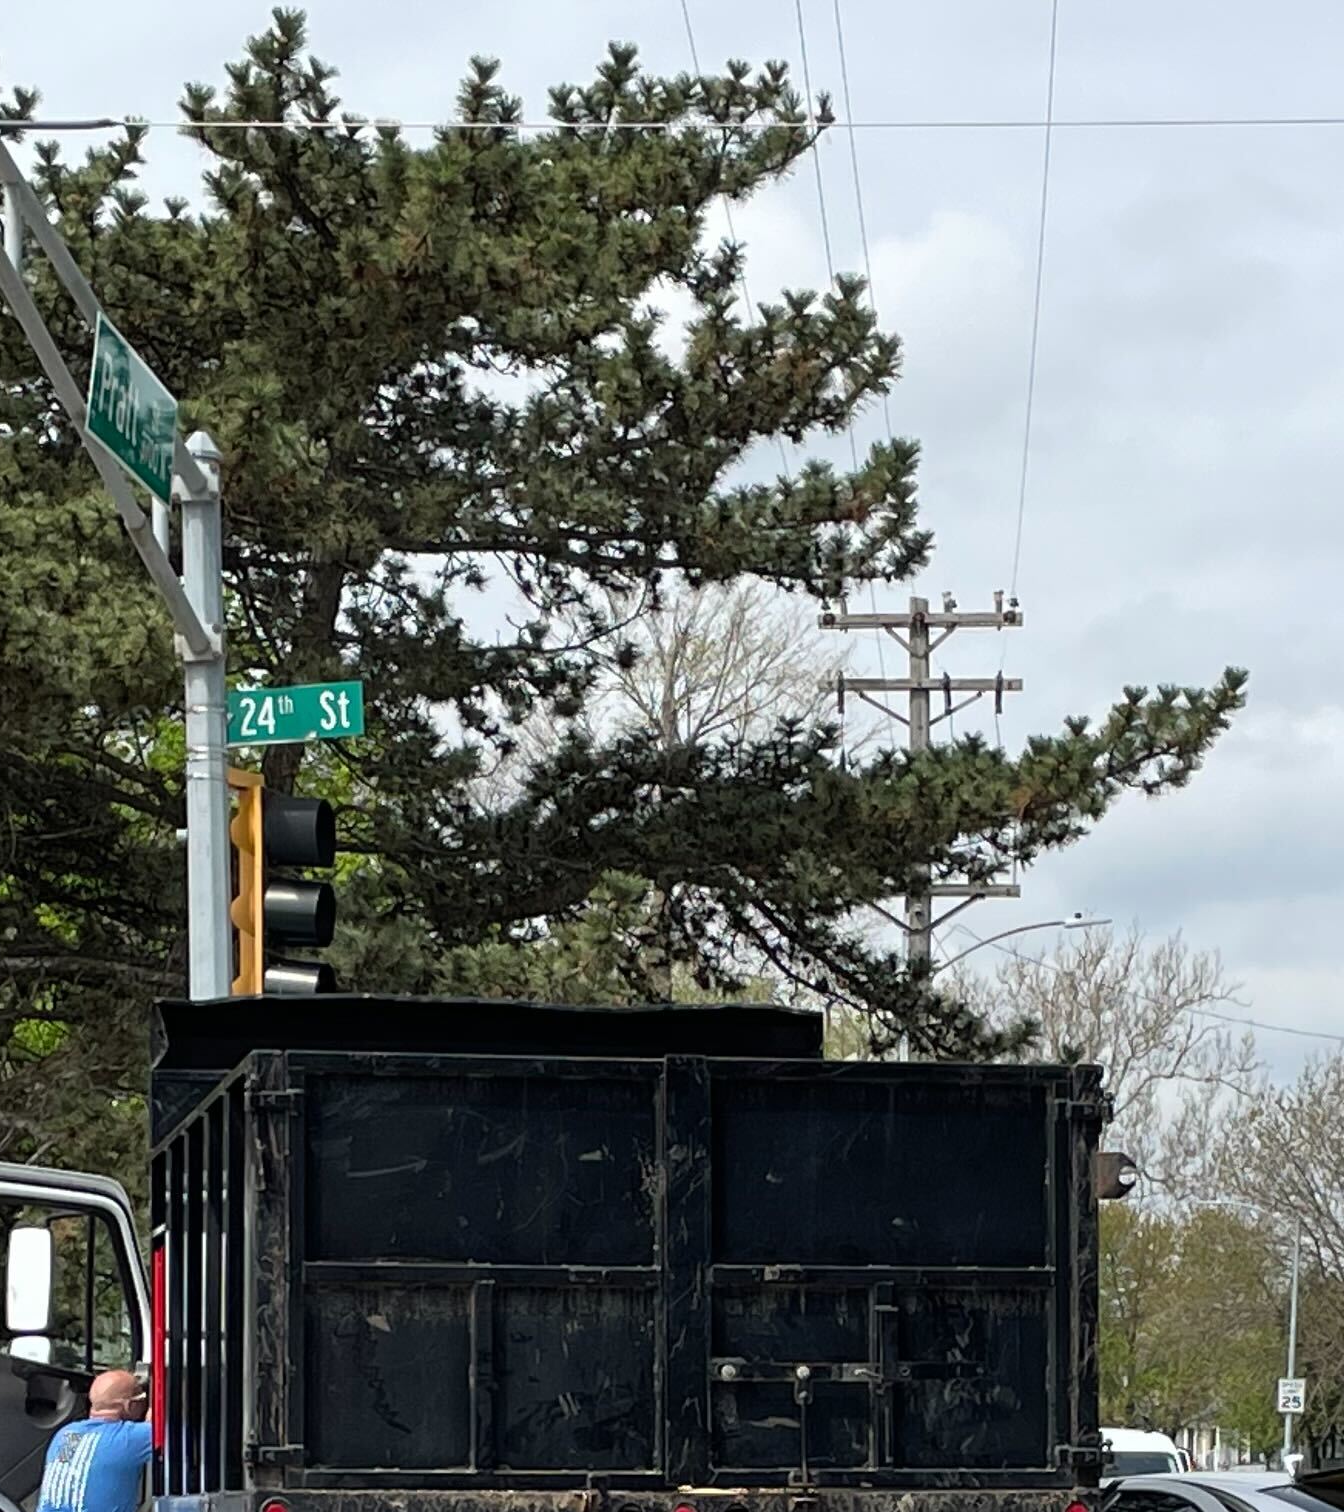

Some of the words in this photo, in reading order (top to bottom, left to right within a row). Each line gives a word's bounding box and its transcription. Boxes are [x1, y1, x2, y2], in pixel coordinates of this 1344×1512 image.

[99, 352, 141, 447] Pratt
[240, 694, 294, 737] 24th
[319, 689, 351, 730] St
[1281, 1395, 1302, 1409] 25
